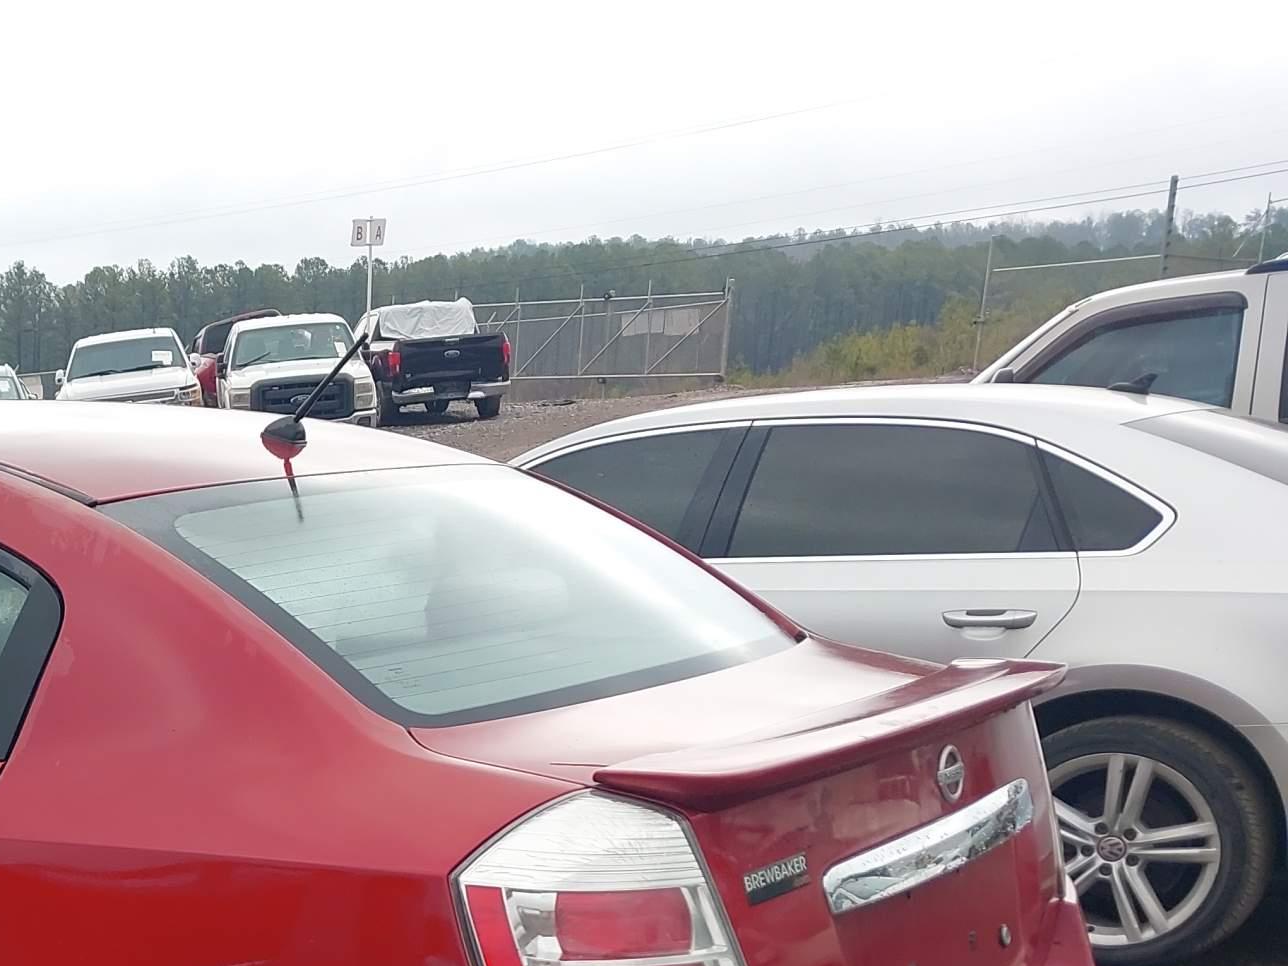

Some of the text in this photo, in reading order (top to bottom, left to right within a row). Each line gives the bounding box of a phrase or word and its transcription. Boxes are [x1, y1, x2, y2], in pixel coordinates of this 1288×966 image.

[356, 225, 364, 241] B
[375, 225, 382, 241] A
[743, 855, 808, 893] BREWBAKER
